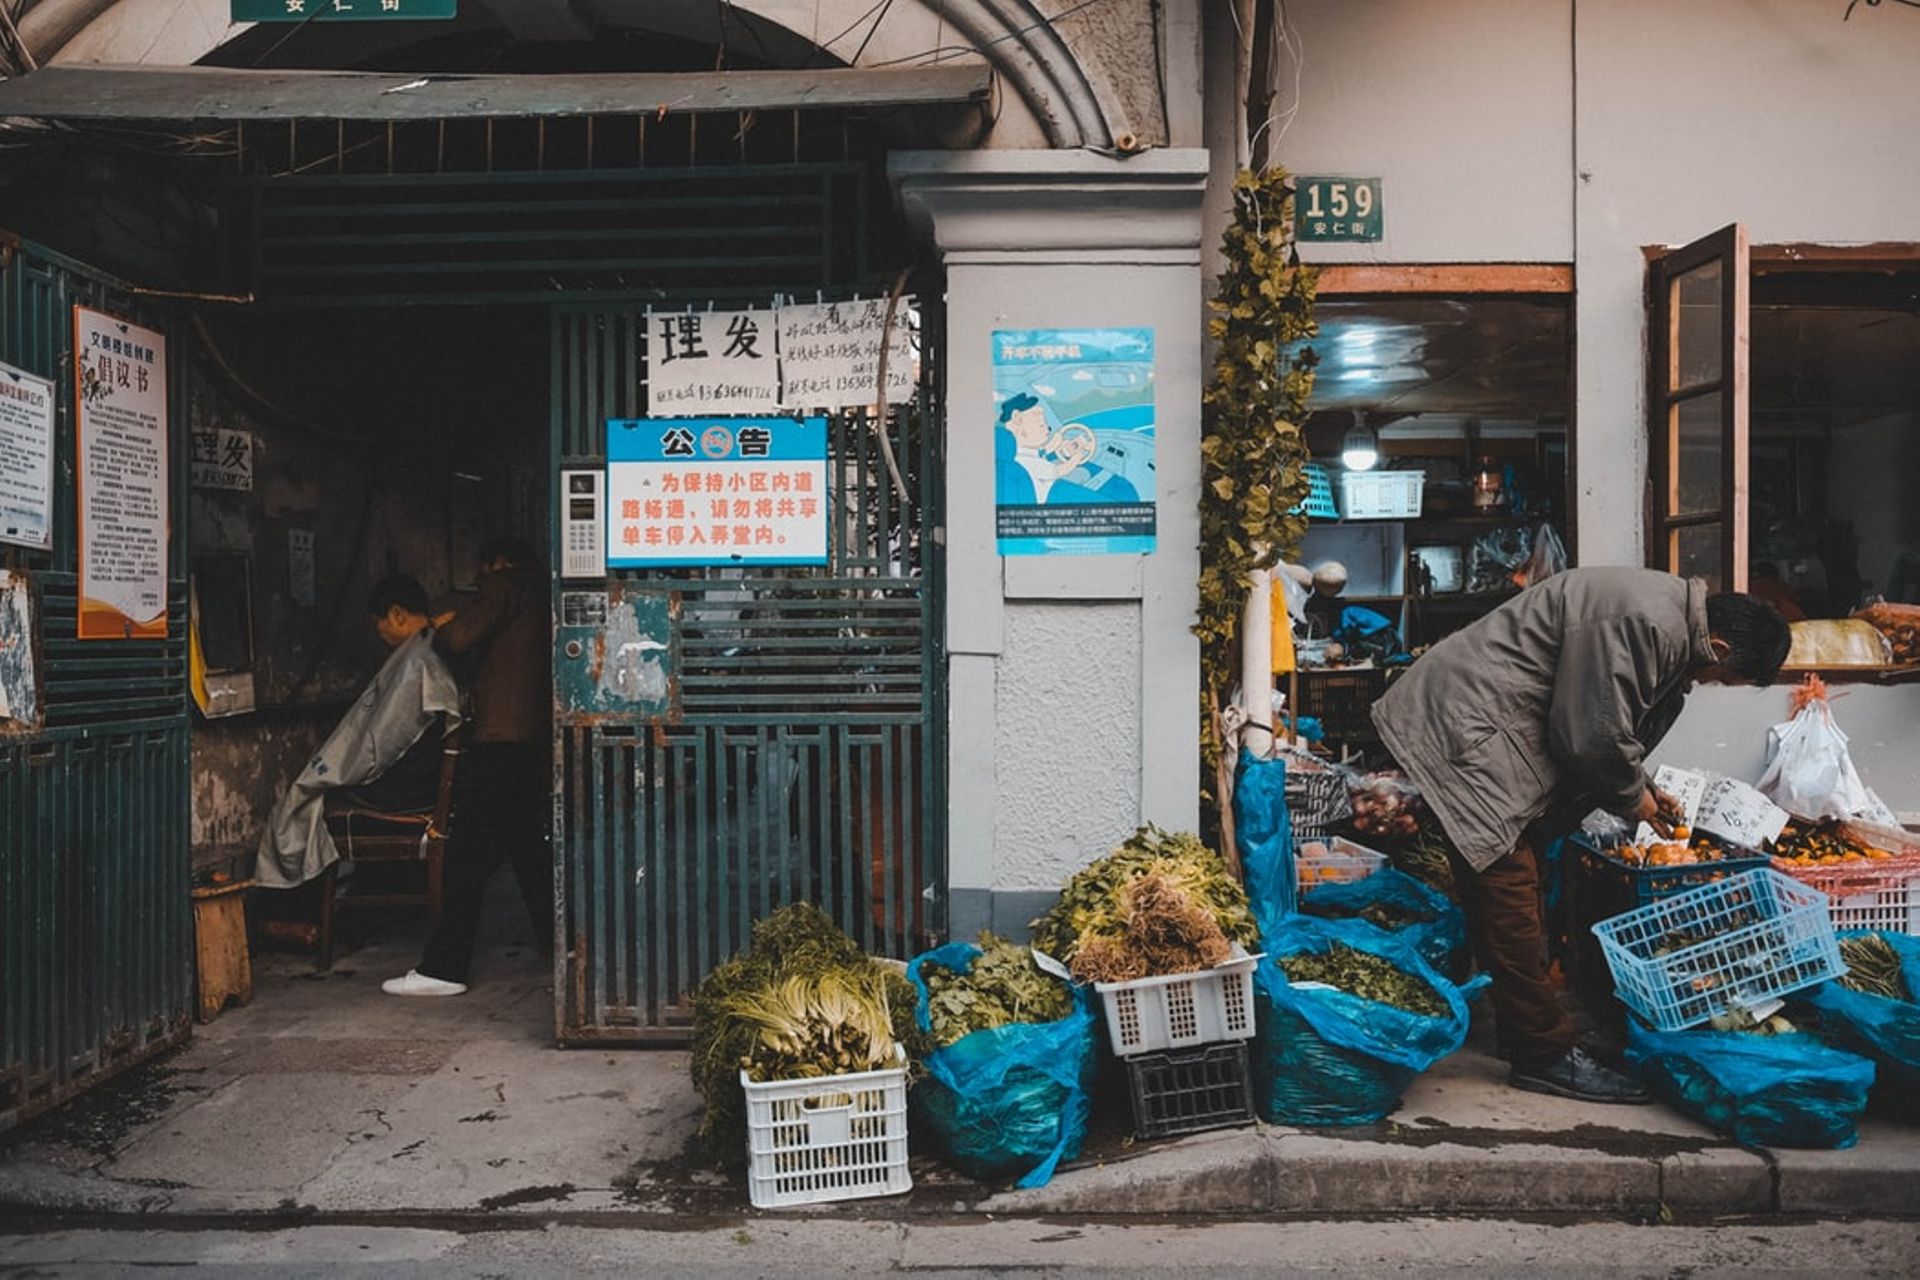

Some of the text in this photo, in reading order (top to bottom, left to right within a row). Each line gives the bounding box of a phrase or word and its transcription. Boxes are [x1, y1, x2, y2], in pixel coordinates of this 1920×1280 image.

[1306, 184, 1373, 218] 159
[1313, 221, 1365, 235] 安仁街
[658, 314, 763, 366] 理发
[98, 354, 149, 394] 倡议书
[660, 427, 771, 458] 公告
[661, 472, 813, 493] 为保持小区内道
[621, 498, 818, 519] 路畅通，请勿将共享
